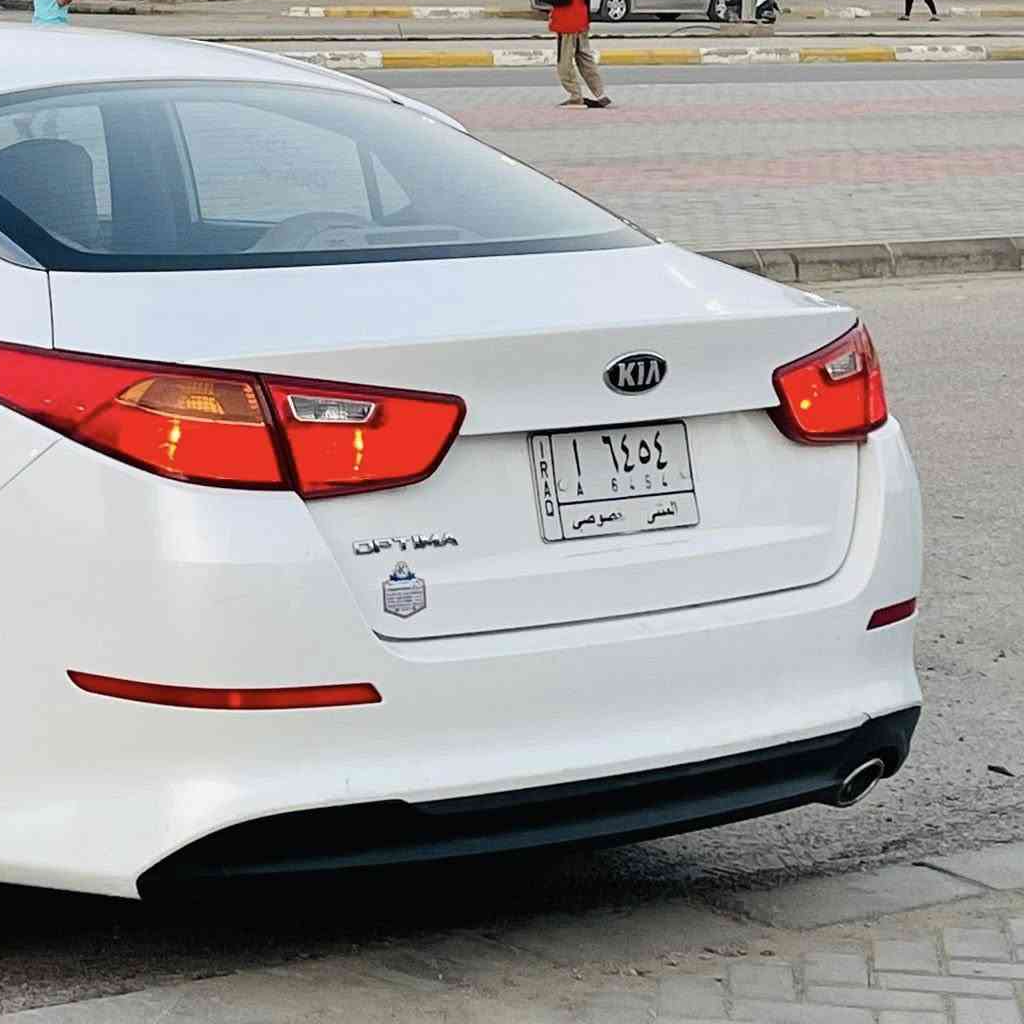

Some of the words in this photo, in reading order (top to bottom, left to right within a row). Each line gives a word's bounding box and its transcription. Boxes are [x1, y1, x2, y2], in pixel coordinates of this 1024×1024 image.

[618, 360, 660, 387] KIA
[601, 430, 668, 473] ٦٤٥٤
[539, 440, 555, 517] IRAQ
[352, 533, 459, 556] OPTIMA
